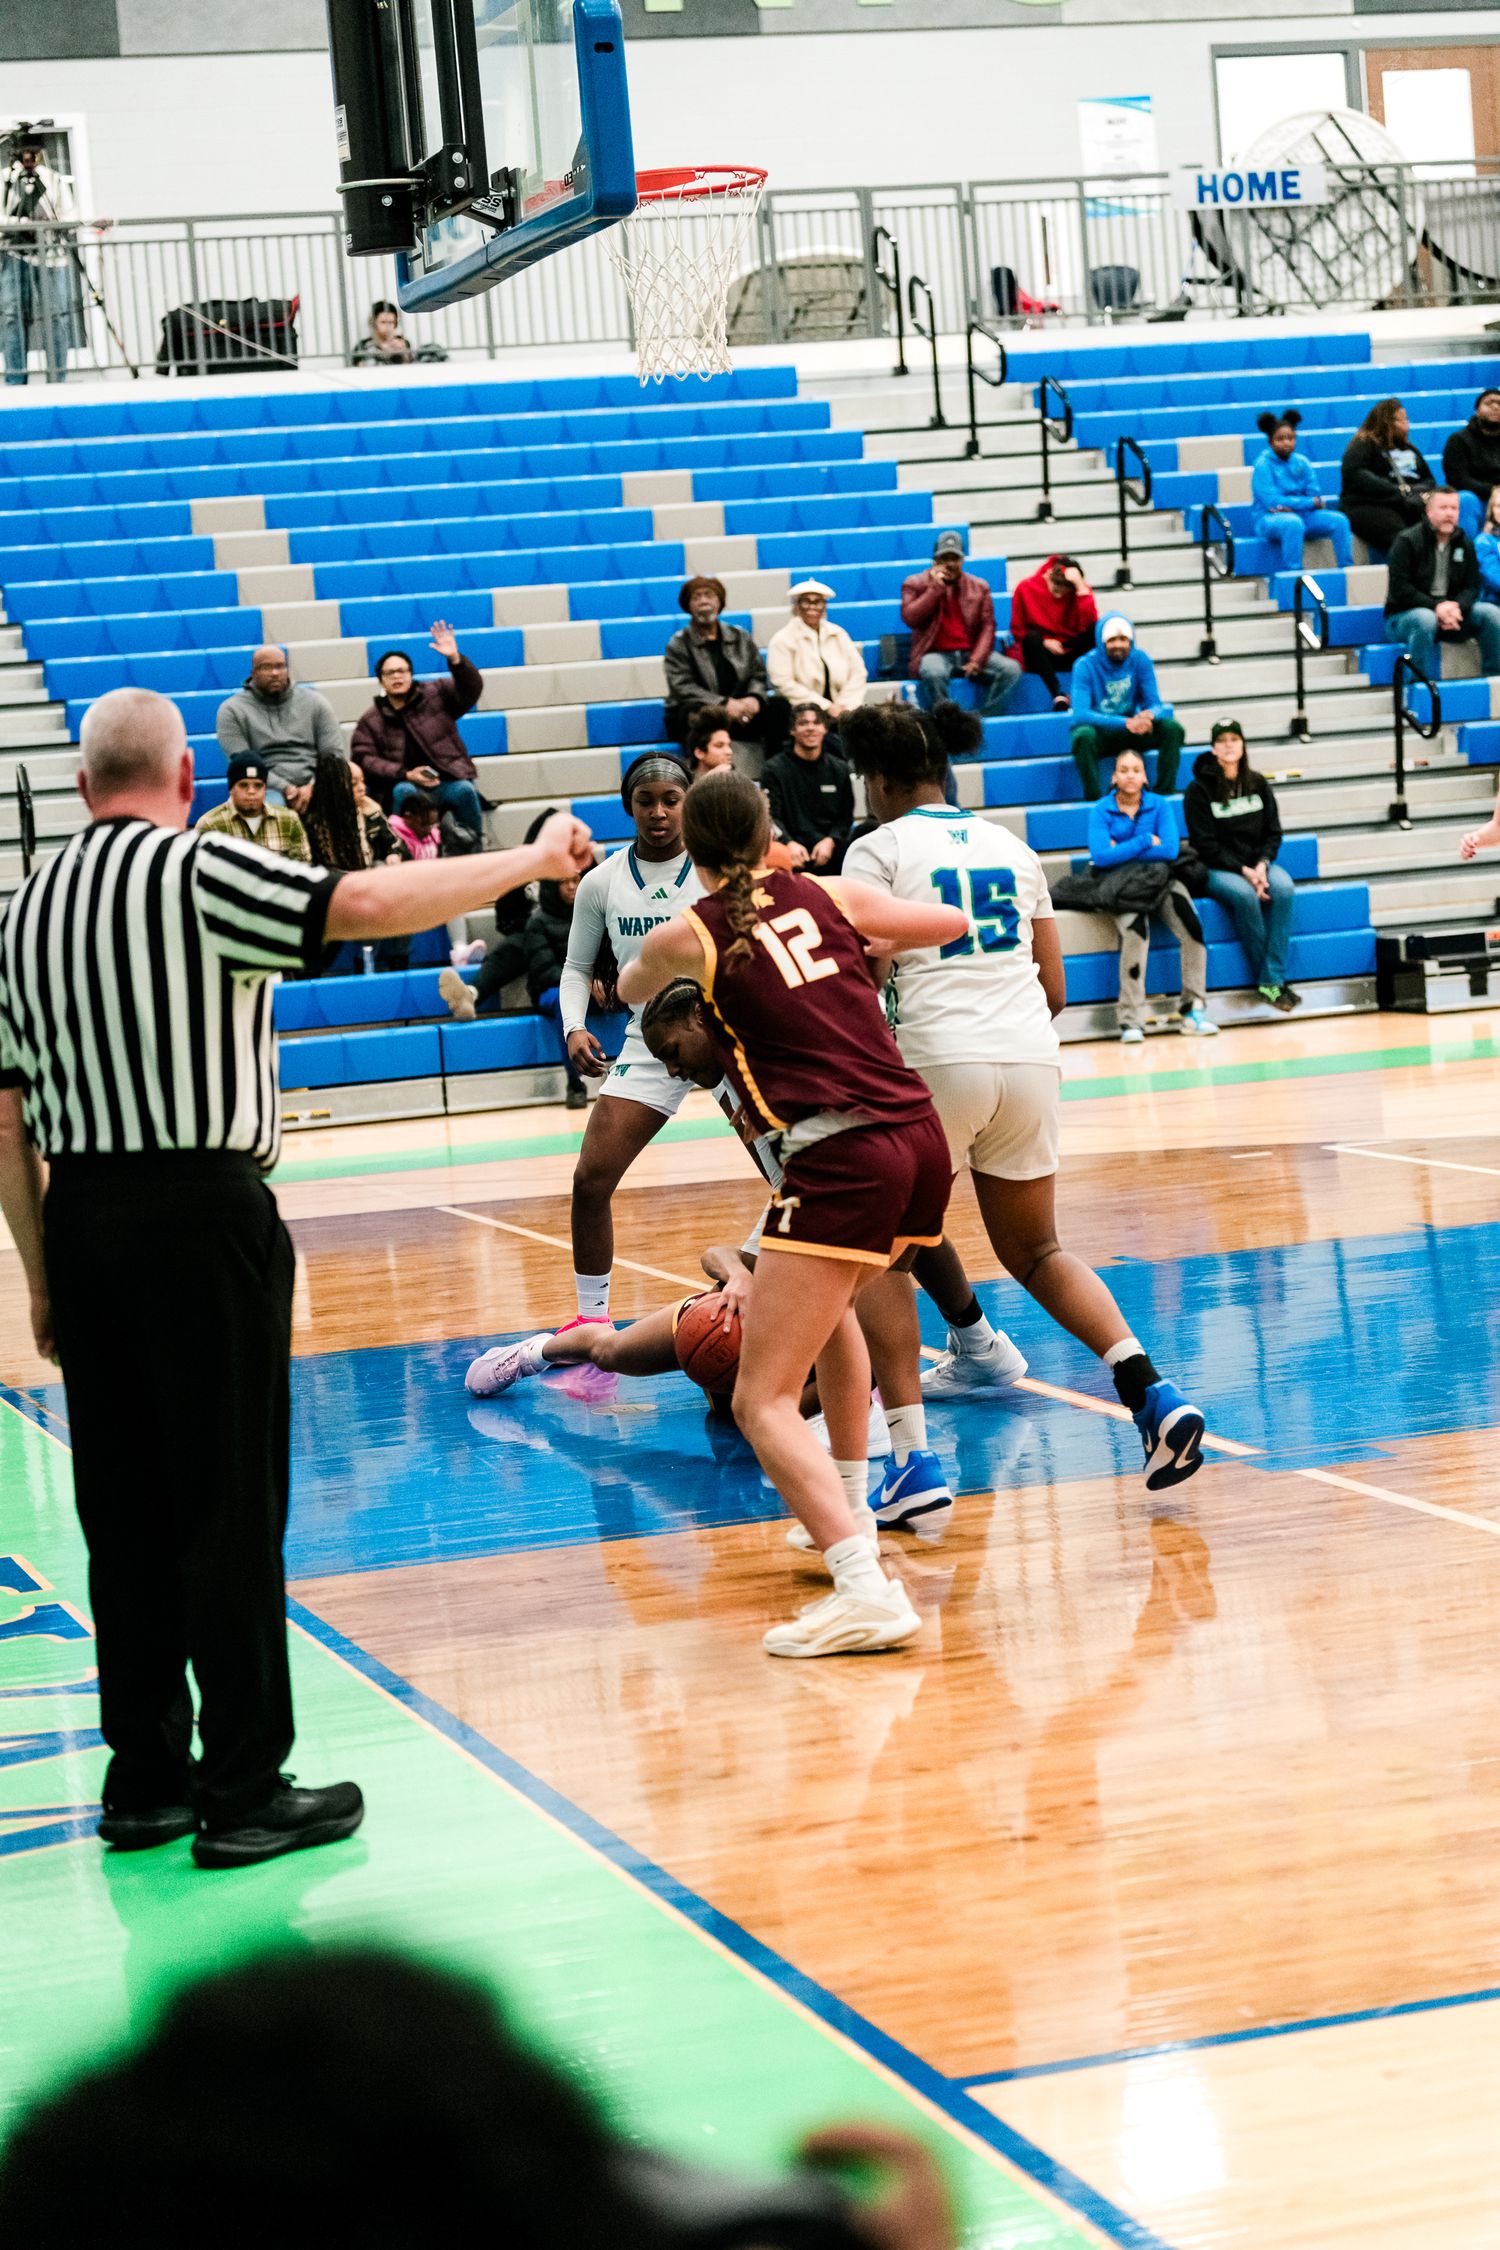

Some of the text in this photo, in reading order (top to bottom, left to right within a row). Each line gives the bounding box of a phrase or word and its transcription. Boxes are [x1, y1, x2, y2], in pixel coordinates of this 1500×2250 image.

[1197, 170, 1301, 203] HOME
[751, 907, 840, 990] 12
[930, 866, 1022, 960] 15
